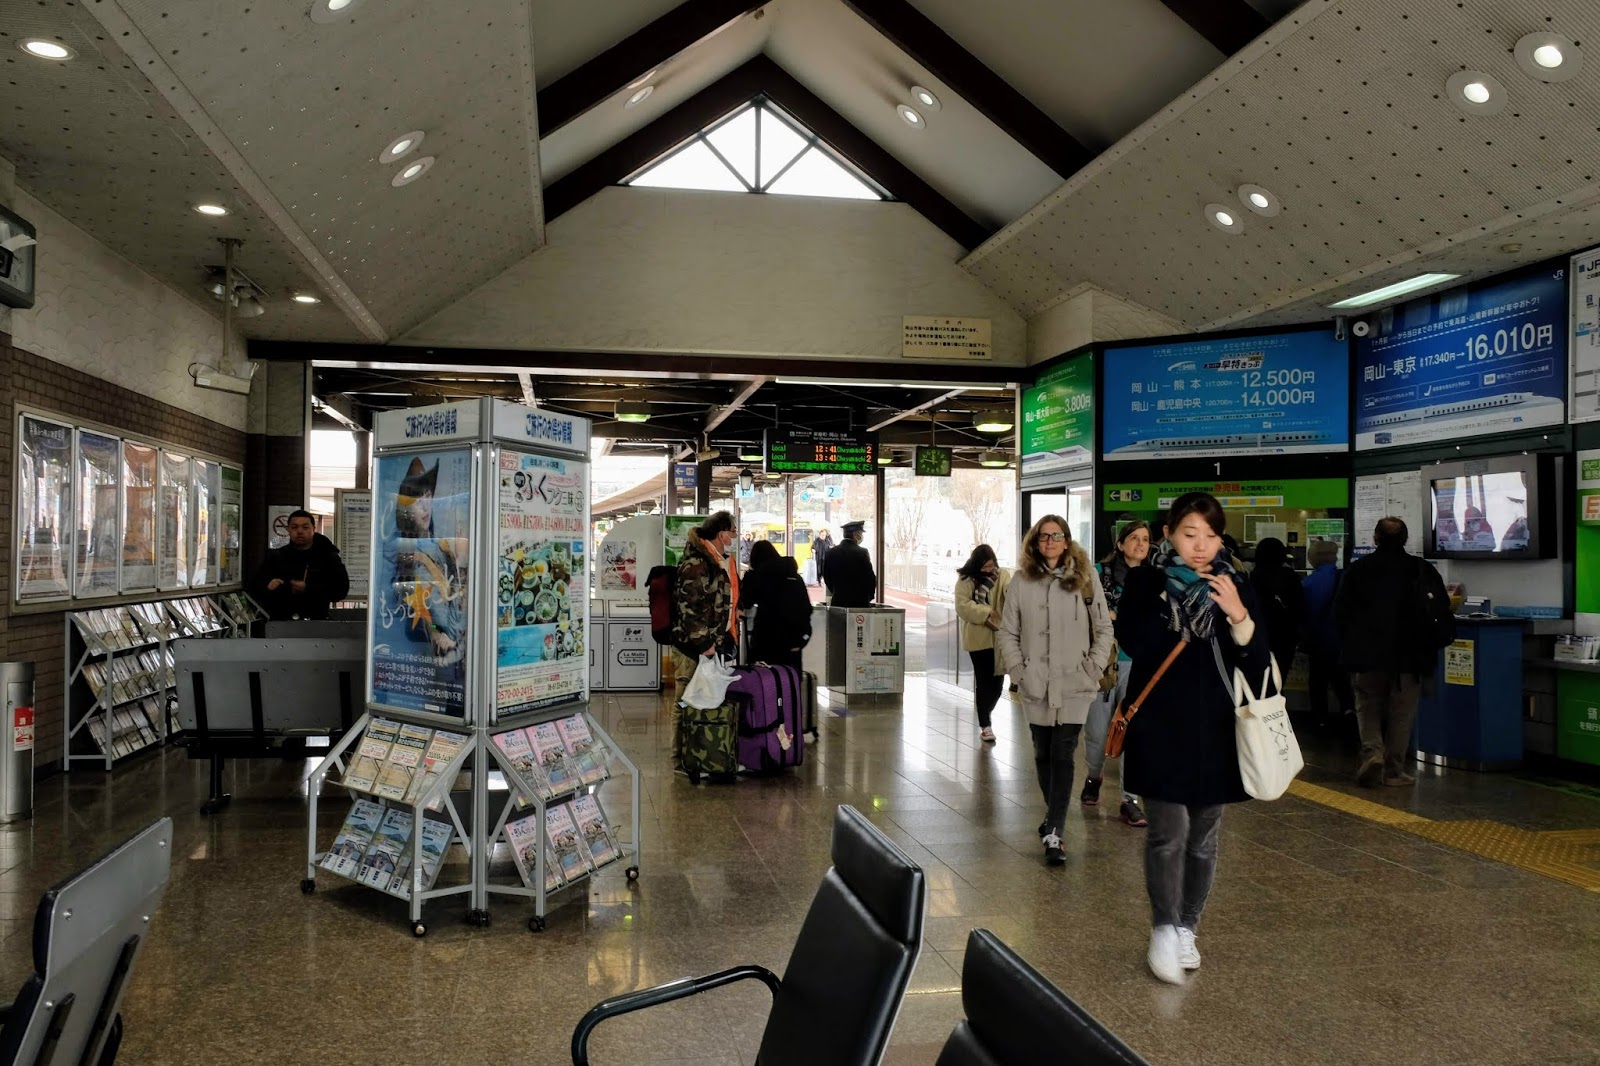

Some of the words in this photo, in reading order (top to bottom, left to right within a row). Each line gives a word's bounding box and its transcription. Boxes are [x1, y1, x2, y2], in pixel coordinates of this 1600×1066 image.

[1465, 323, 1553, 361] 16,010円
[1241, 368, 1315, 388] 12,500円
[1241, 388, 1315, 408] 14,000円
[405, 408, 457, 438] ご旅行のお得な情報
[526, 413, 573, 445] ご旅行のお得な情報
[771, 444, 786, 452] Local
[815, 445, 837, 453] 12:41
[836, 446, 866, 454] Chayamachi
[866, 446, 872, 454] 2
[771, 452, 786, 460] Local
[815, 454, 837, 462] 13:41
[1213, 461, 1221, 476] 1
[828, 486, 835, 498] 2
